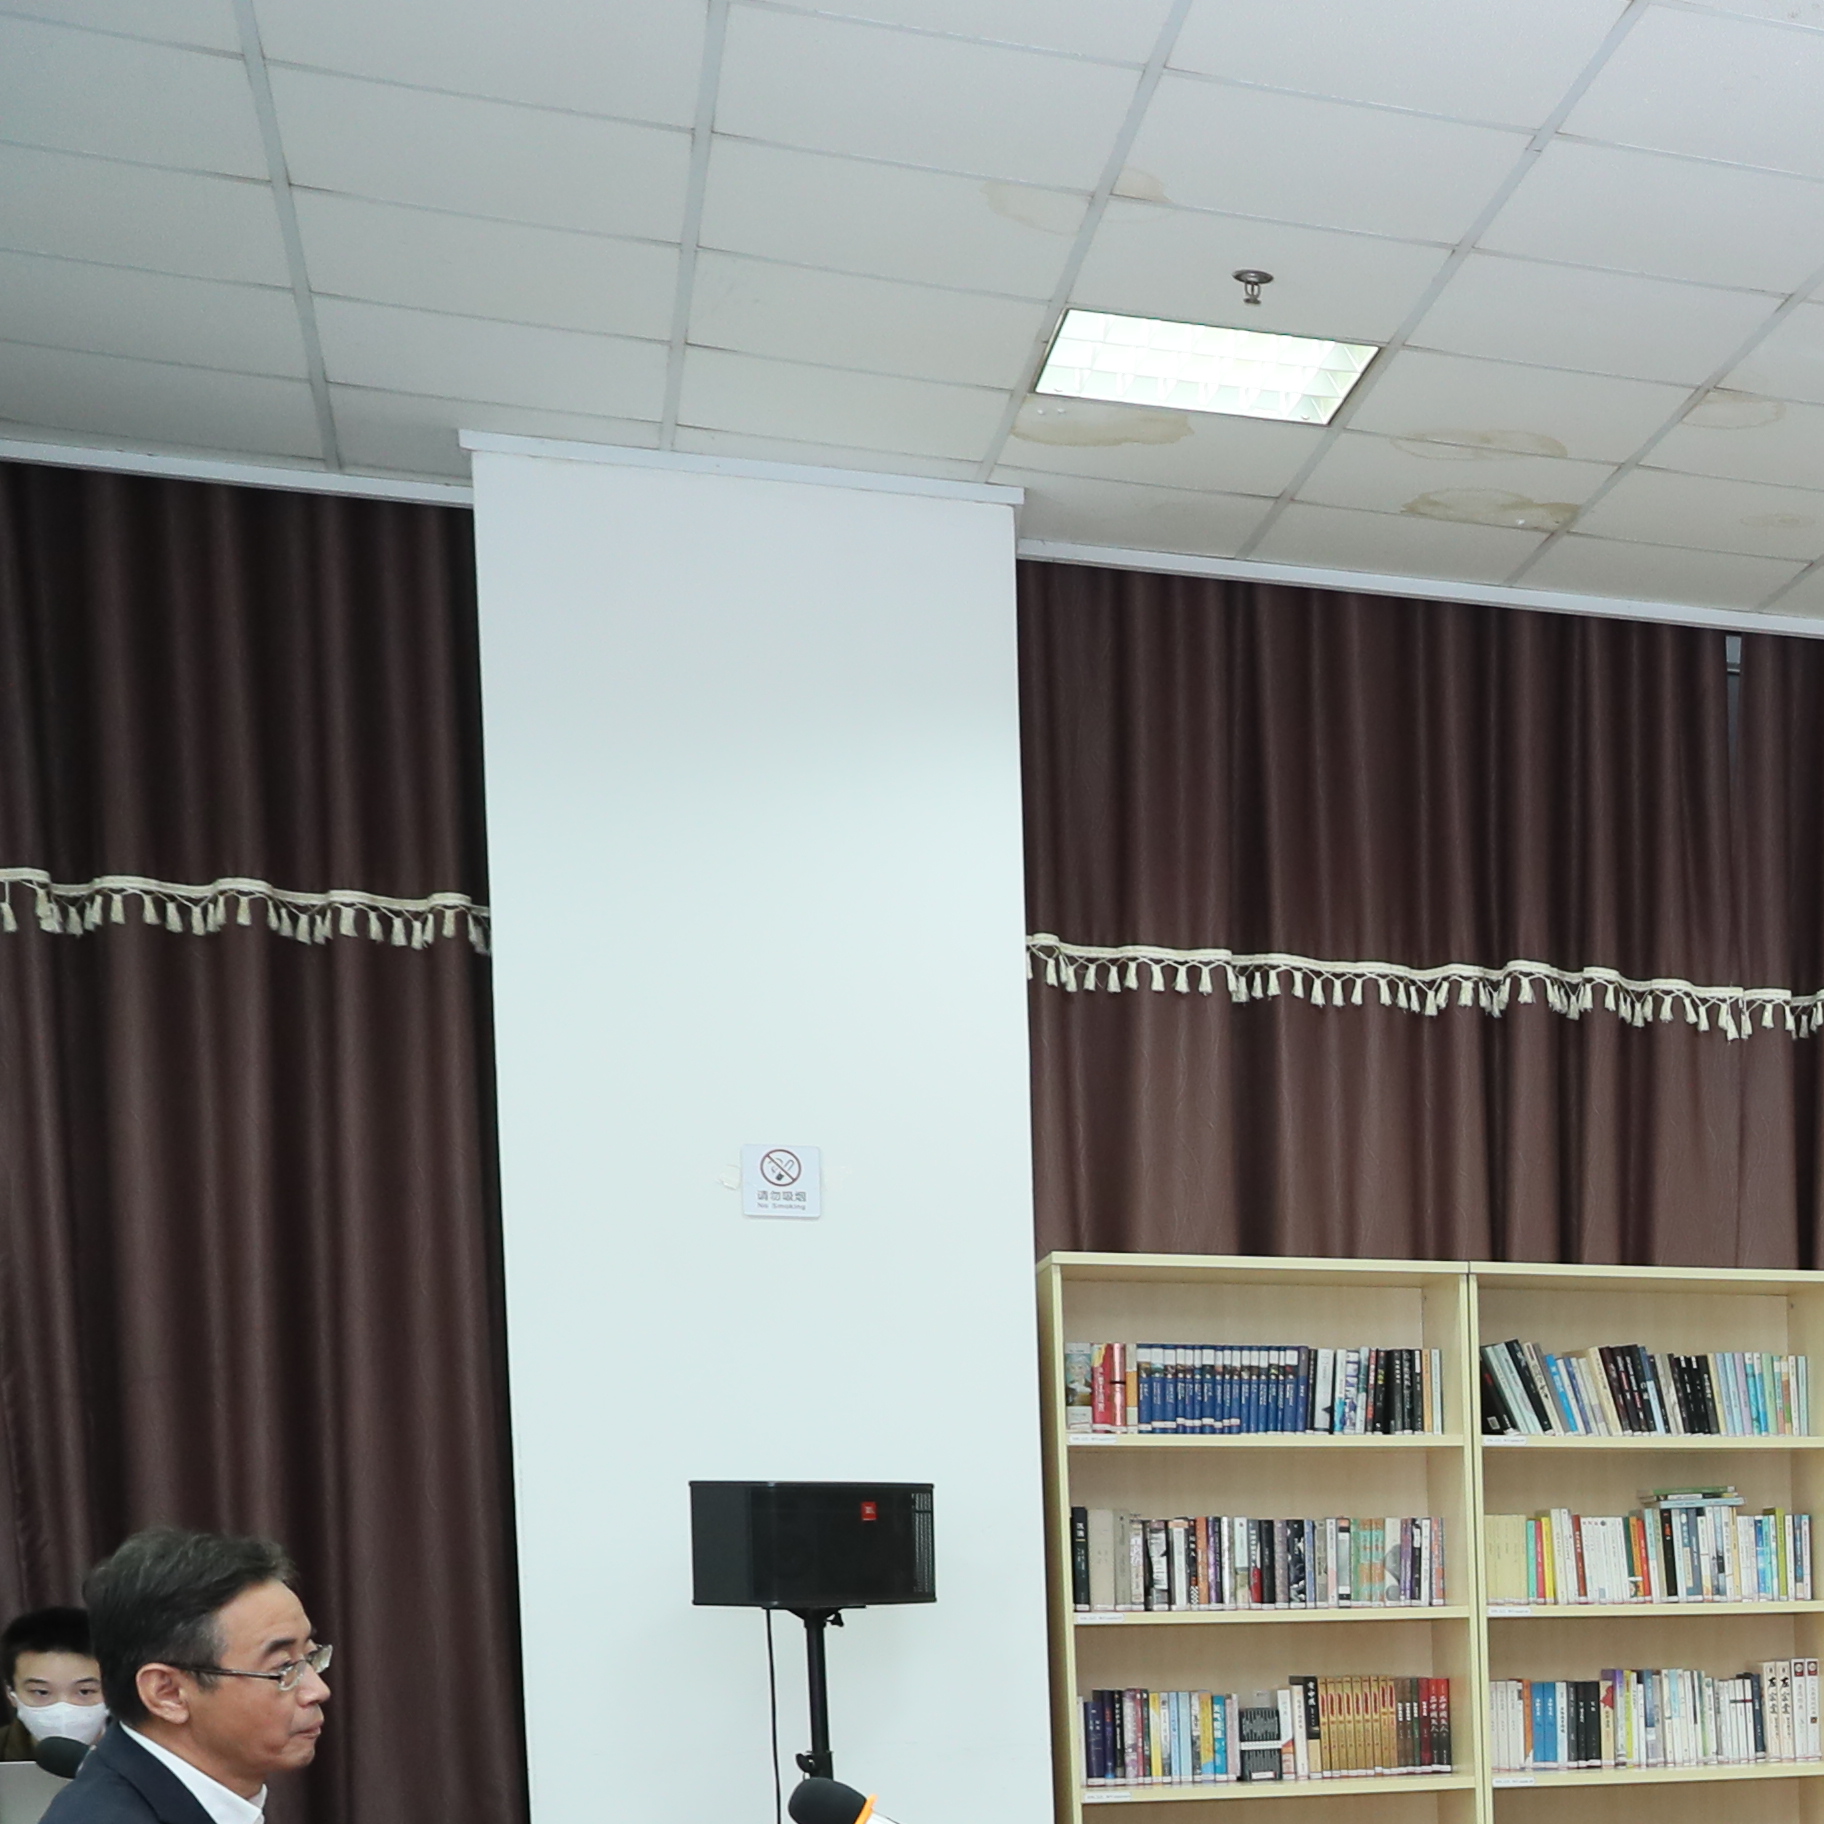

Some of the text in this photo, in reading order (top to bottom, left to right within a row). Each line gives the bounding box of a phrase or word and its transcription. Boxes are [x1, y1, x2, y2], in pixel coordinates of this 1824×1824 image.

[757, 1190, 806, 1202] 请勿吸烟
[772, 1203, 806, 1211] Smoking
